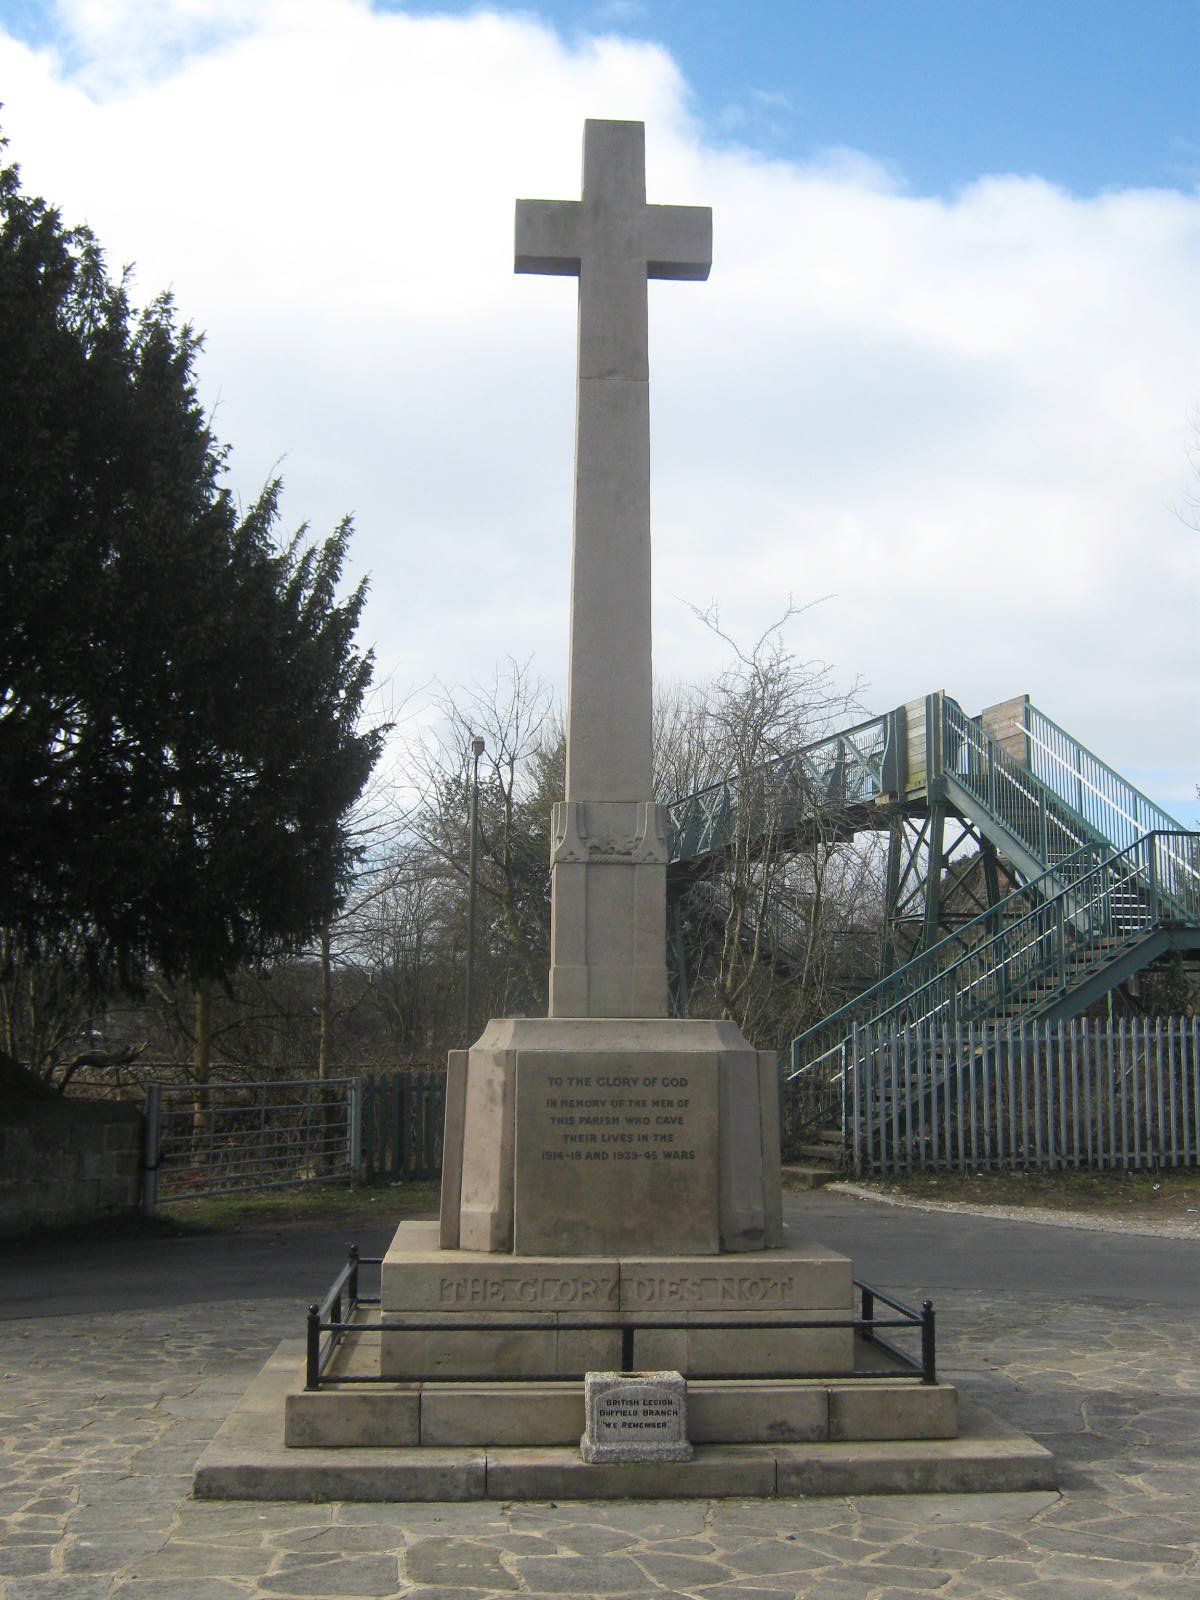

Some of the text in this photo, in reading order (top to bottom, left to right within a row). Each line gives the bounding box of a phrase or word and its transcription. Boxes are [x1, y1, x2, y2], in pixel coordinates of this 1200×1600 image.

[548, 1077, 688, 1088] TO THE GLORY OF GOD
[546, 1100, 690, 1108] IN MEMORY OF THE MEN OF
[551, 1116, 684, 1125] THIS PARISH WHO GAVE
[563, 1134, 674, 1143] THEIR LIVES IN THE
[584, 1151, 609, 1160] AND
[613, 1151, 658, 1160] 1939-45
[662, 1151, 696, 1160] WARS
[441, 1278, 793, 1302] THE GLORY DIES NOT
